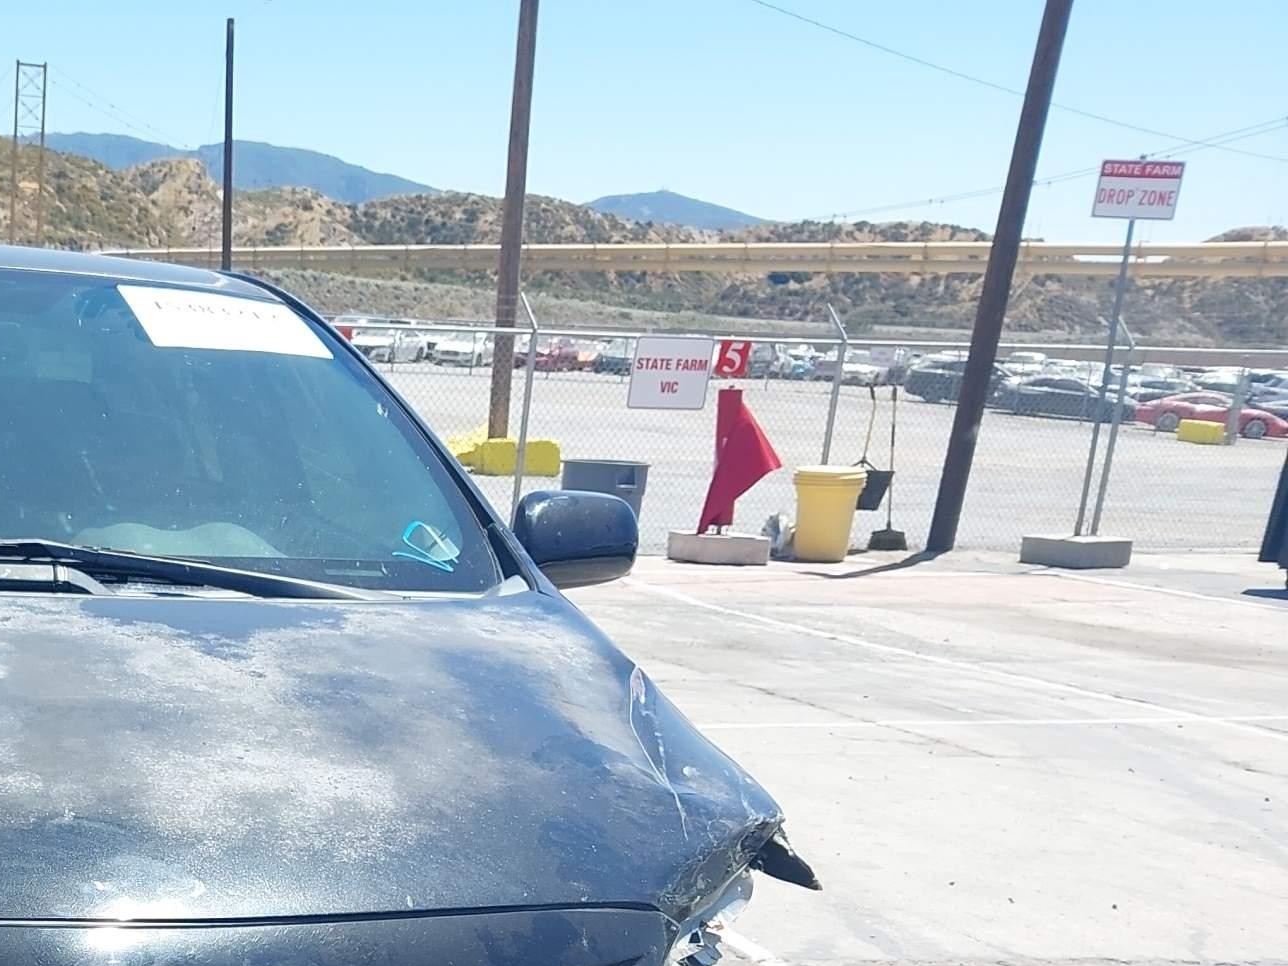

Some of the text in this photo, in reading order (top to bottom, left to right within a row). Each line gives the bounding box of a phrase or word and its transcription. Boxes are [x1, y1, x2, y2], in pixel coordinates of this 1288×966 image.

[1103, 163, 1183, 176] STATE FARM
[1097, 188, 1176, 206] DROP ZONE
[636, 357, 709, 371] STATE FARM
[722, 341, 746, 373] 5
[660, 381, 679, 394] VIC
